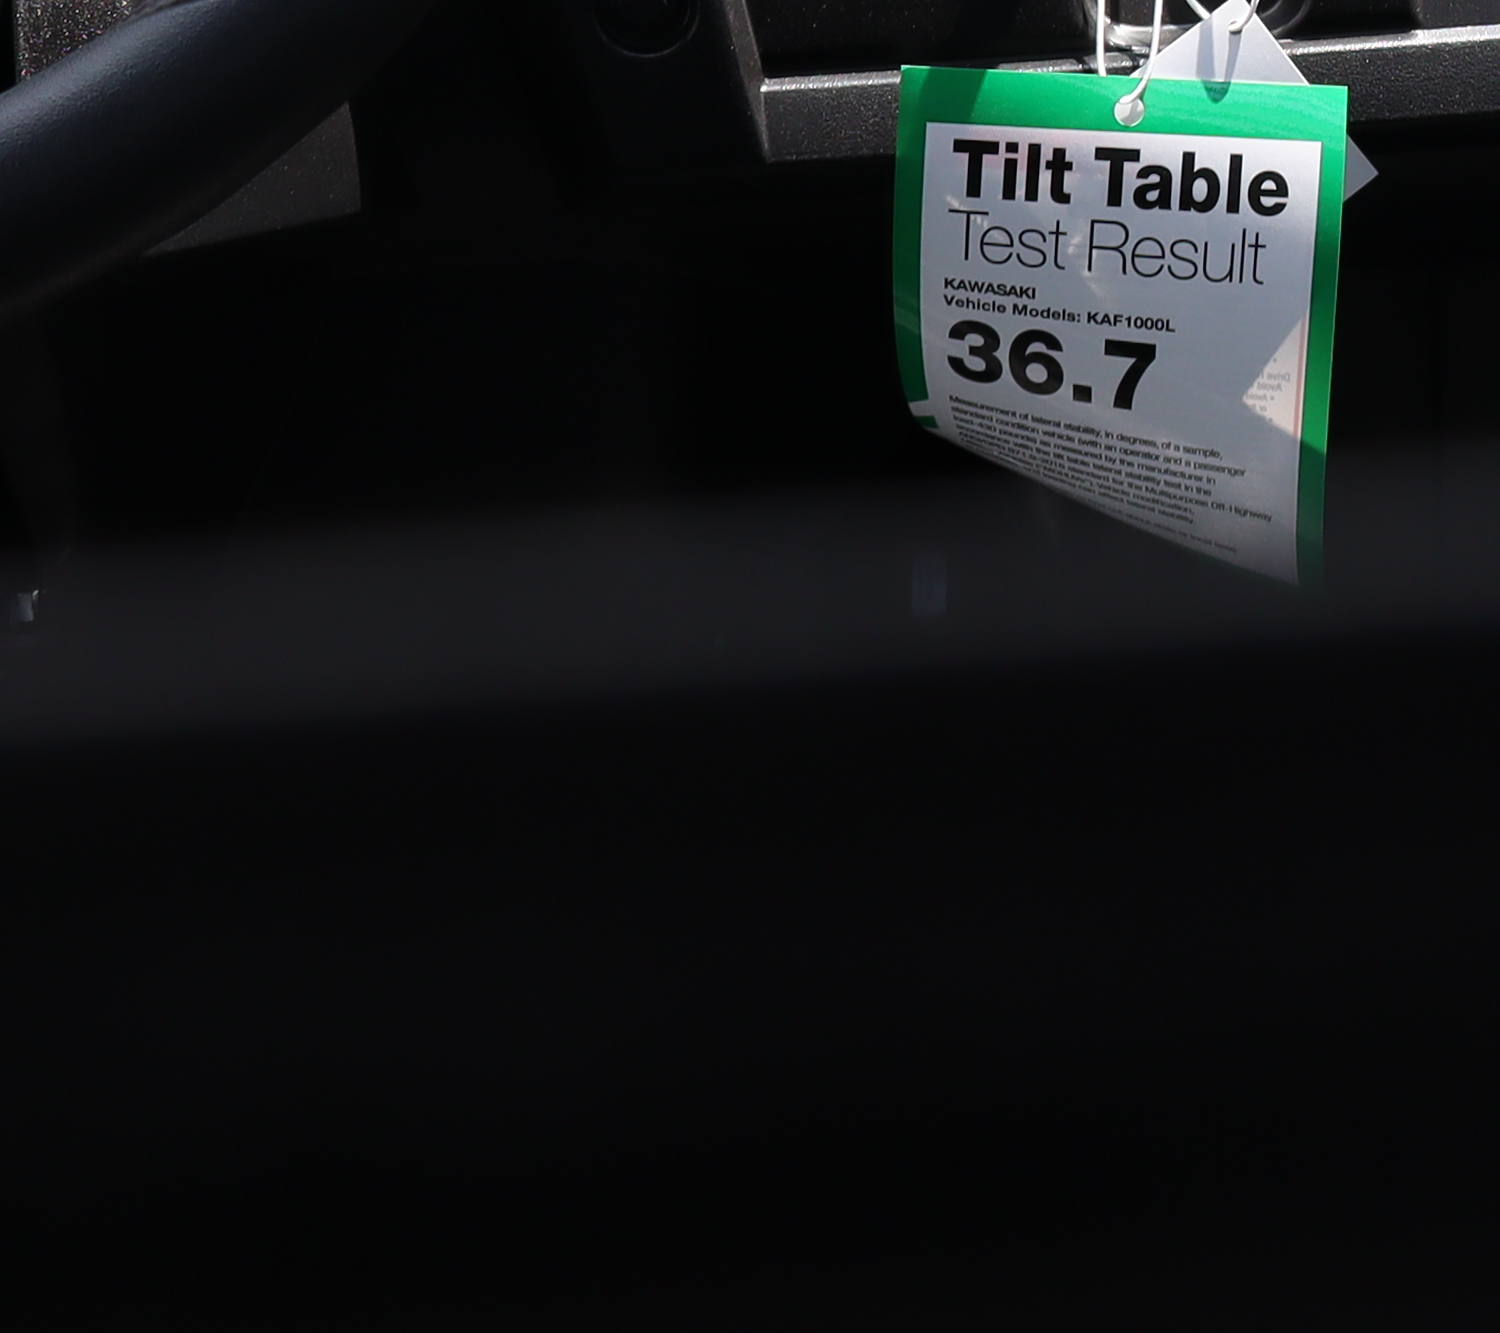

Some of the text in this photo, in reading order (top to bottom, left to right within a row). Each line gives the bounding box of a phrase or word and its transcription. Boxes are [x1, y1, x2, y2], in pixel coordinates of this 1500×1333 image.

[953, 137, 1290, 217] Tilt Table
[948, 208, 1267, 286] Test Result
[943, 276, 1037, 300] KAWASAKI
[943, 293, 1177, 334] Vehicle Models: KAF1000L
[946, 319, 1158, 411] 36.7
[949, 394, 1018, 418] Measurement
[1019, 411, 1030, 421] of
[1031, 413, 1062, 429] lateral
[1104, 429, 1114, 440] in
[1161, 441, 1172, 450] of
[1173, 444, 1181, 452] a
[1182, 445, 1223, 461] sample,
[1041, 426, 1076, 443] vehicle
[1163, 455, 1182, 467] and
[1184, 460, 1192, 468] a
[1193, 461, 1248, 478] passenger
